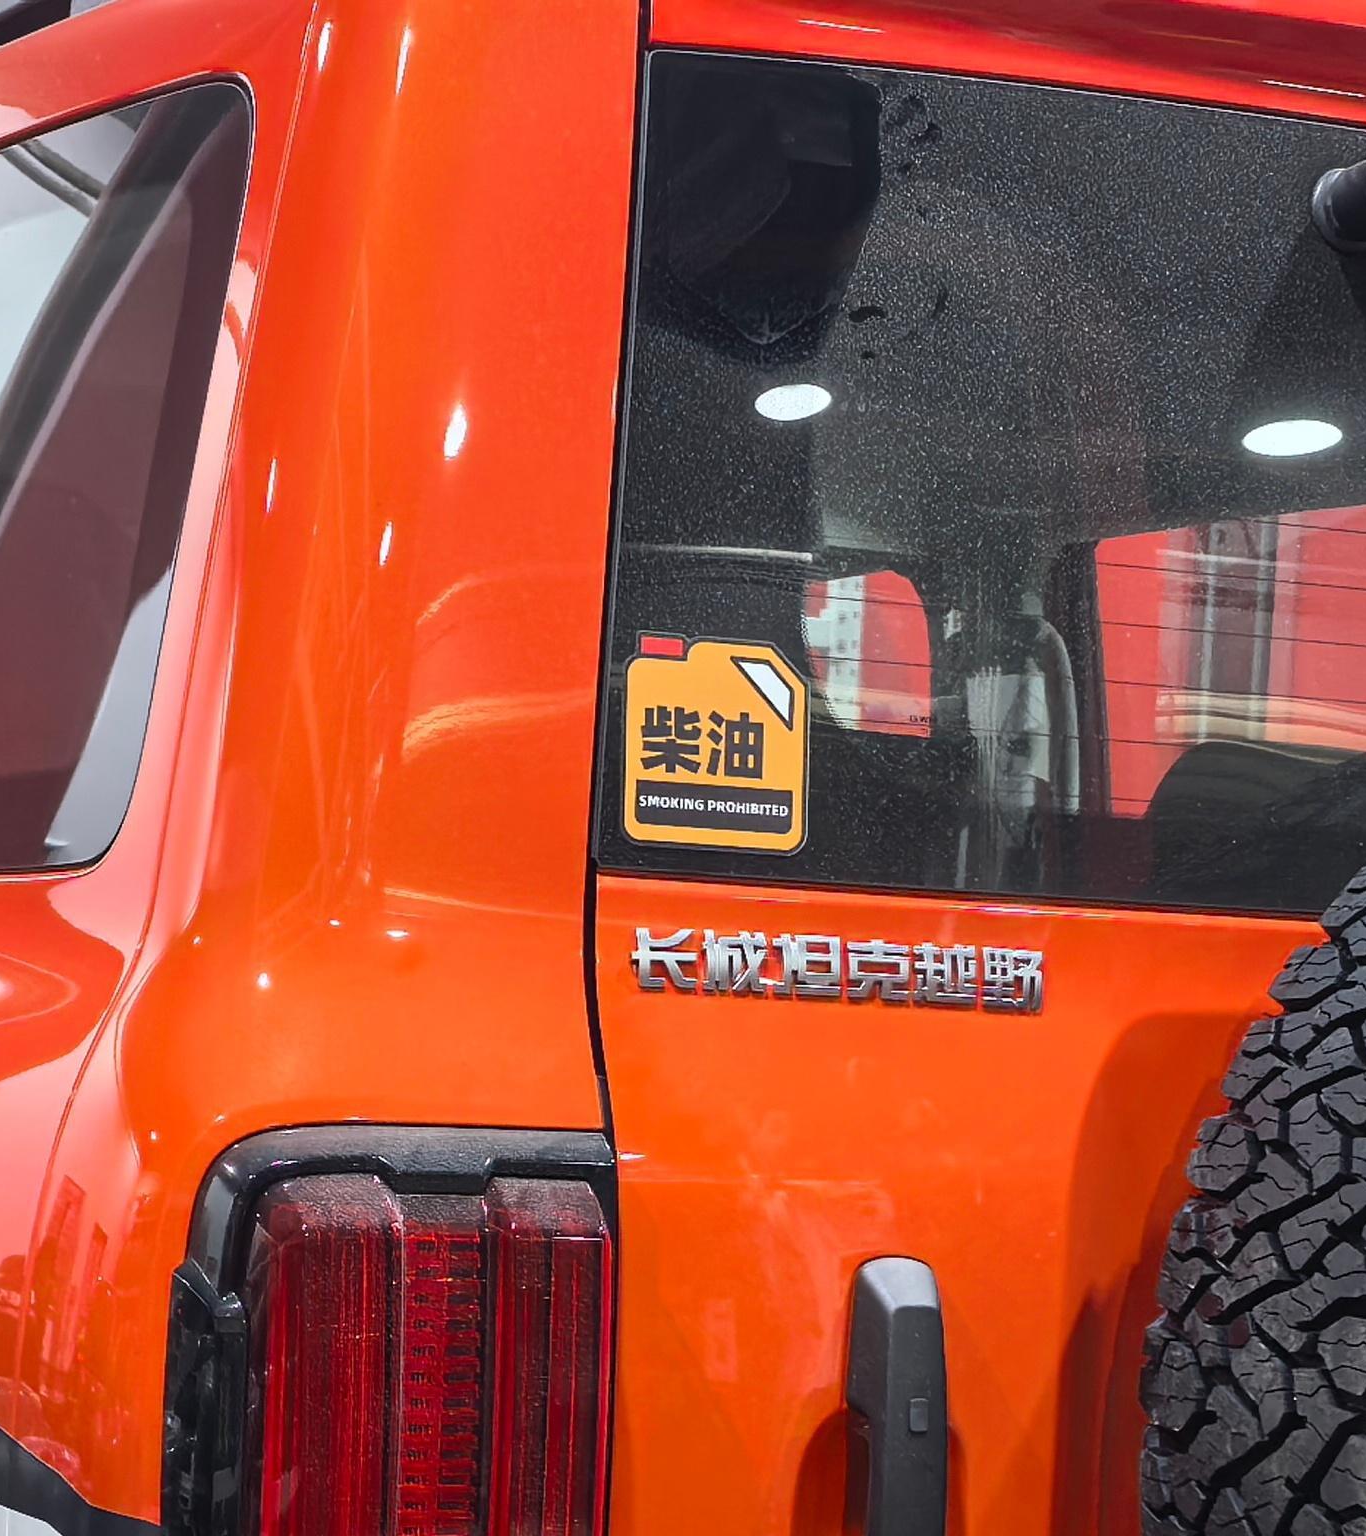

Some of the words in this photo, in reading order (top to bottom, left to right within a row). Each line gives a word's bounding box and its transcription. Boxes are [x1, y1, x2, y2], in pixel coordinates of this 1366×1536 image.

[640, 705, 764, 780] 柴油
[638, 795, 704, 812] SMOKING
[707, 800, 788, 818] PROHIBITED
[631, 927, 1043, 1014] 长城坦克越野
